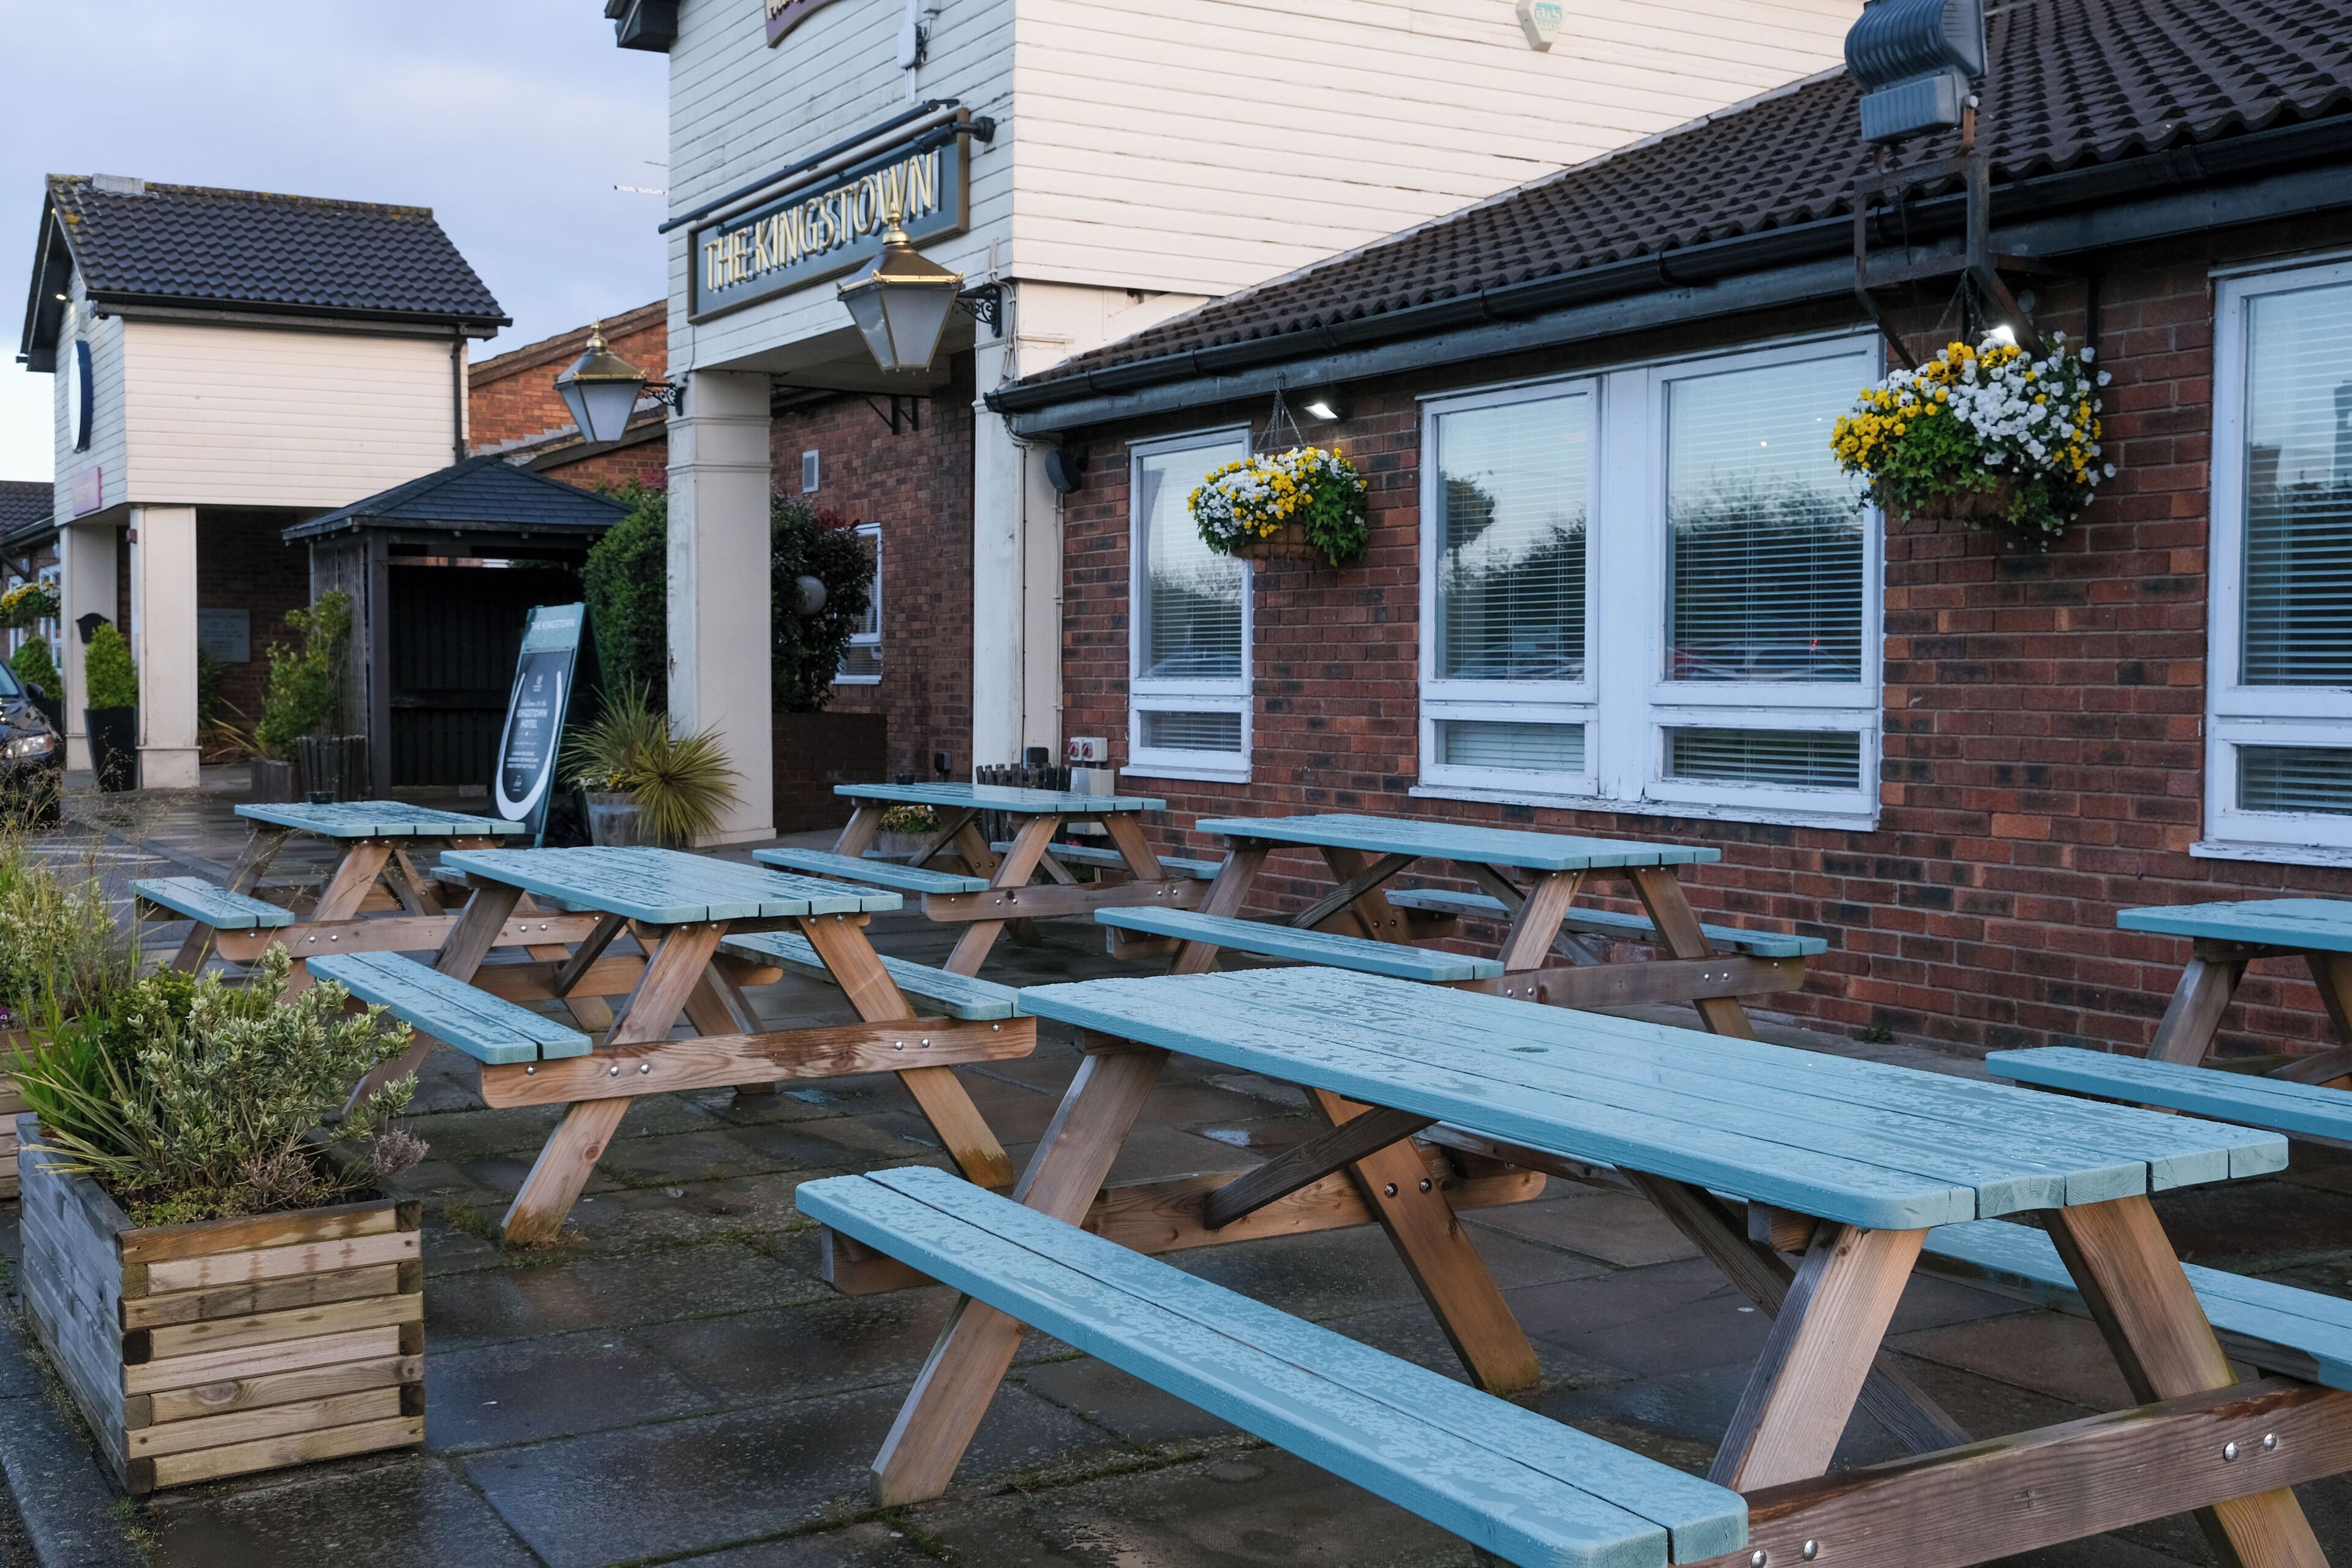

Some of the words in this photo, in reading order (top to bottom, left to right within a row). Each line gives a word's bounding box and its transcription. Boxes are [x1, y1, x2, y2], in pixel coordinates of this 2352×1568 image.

[704, 227, 751, 292] THE
[755, 151, 935, 274] KINGSTOWN
[530, 621, 541, 631] THE
[541, 618, 576, 630] KINGSTOWN
[516, 708, 549, 718] KINGSTOWN
[519, 718, 538, 729] HOTEL
